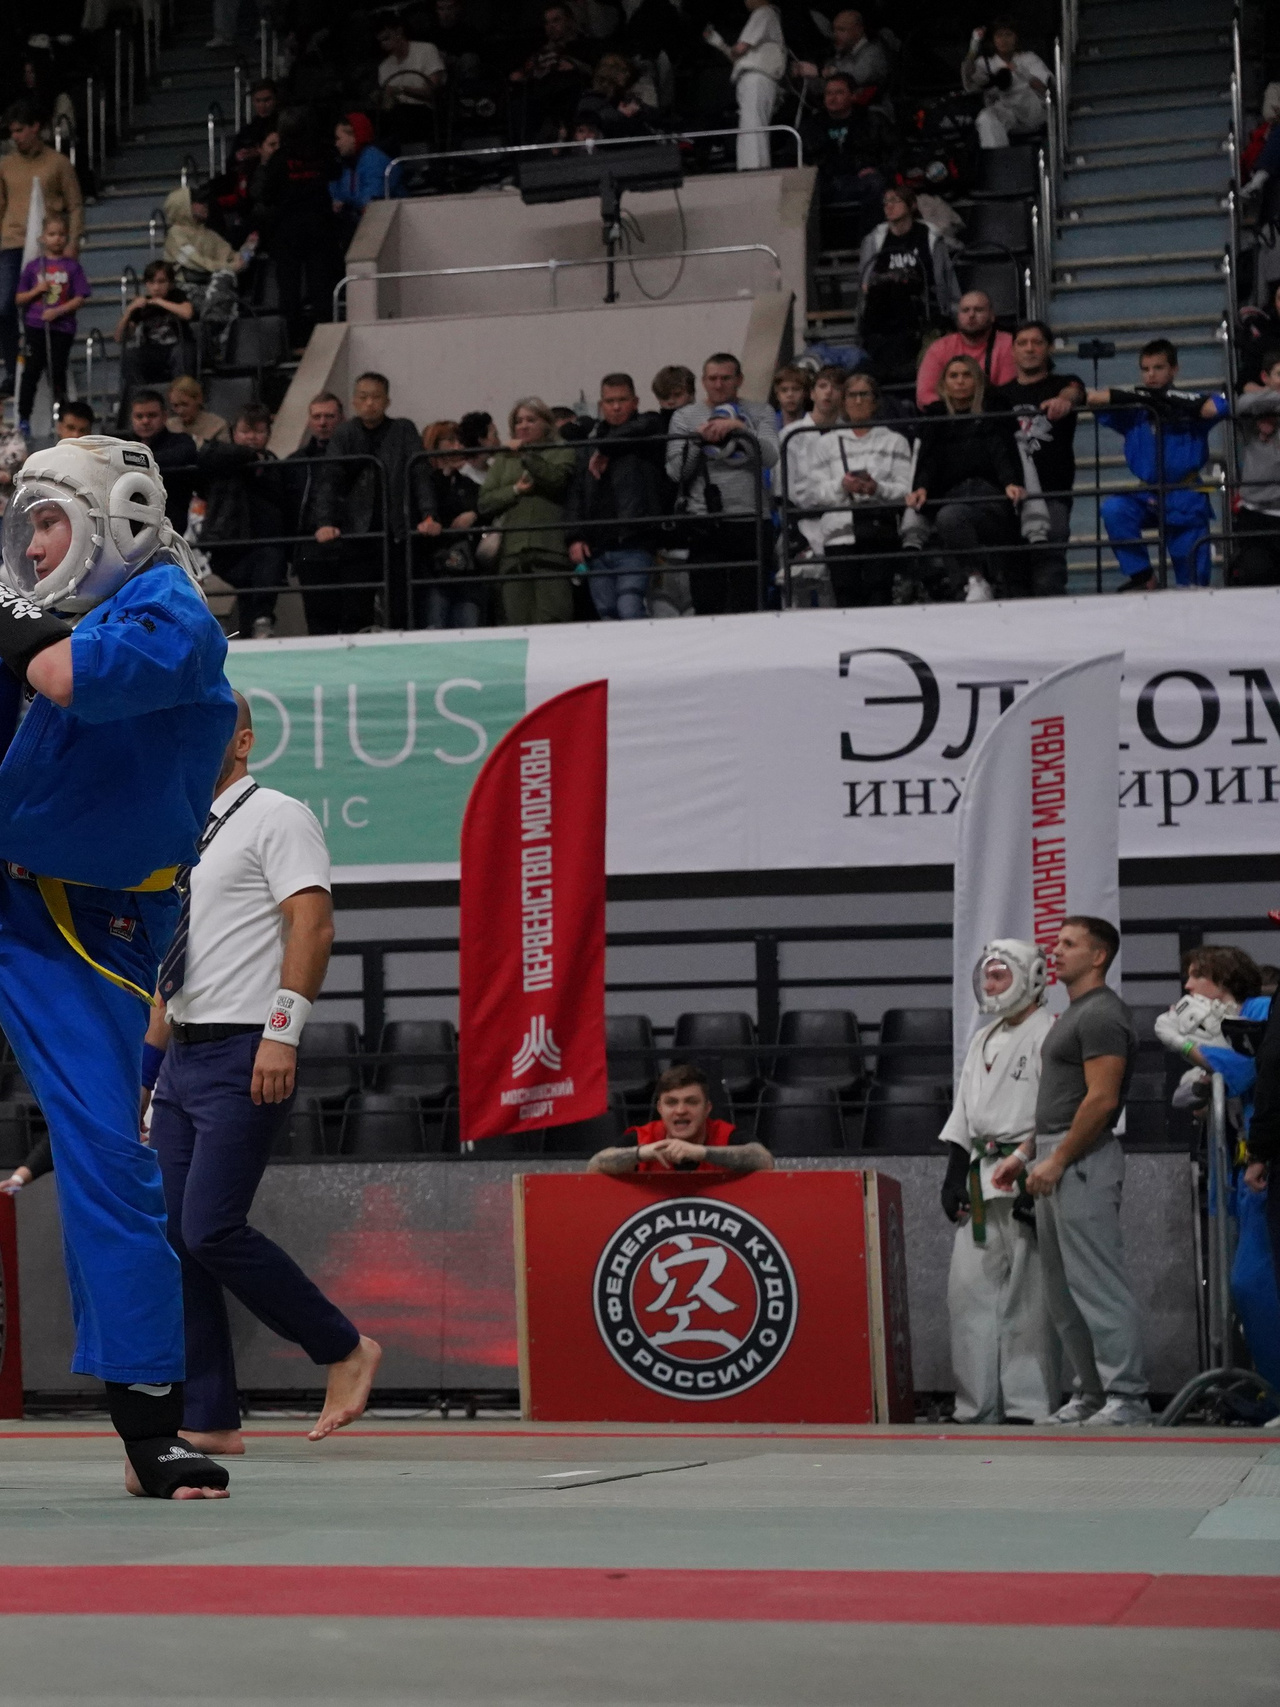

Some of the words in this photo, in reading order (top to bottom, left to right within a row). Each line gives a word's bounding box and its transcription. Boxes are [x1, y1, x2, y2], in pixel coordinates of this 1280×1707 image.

[247, 679, 488, 771] DIUS
[839, 647, 1280, 761] Эло
[520, 738, 552, 838] МОСКВЫ
[1030, 715, 1066, 828] МОСКВЫ
[521, 845, 553, 993] ПЕРВЕНСТВО
[1032, 836, 1067, 986] МПИОНАТ
[607, 1209, 743, 1322] ФЕДЕРАЦИЯ
[745, 1235, 785, 1321] КУДО
[633, 1349, 763, 1389] РОССИИ
